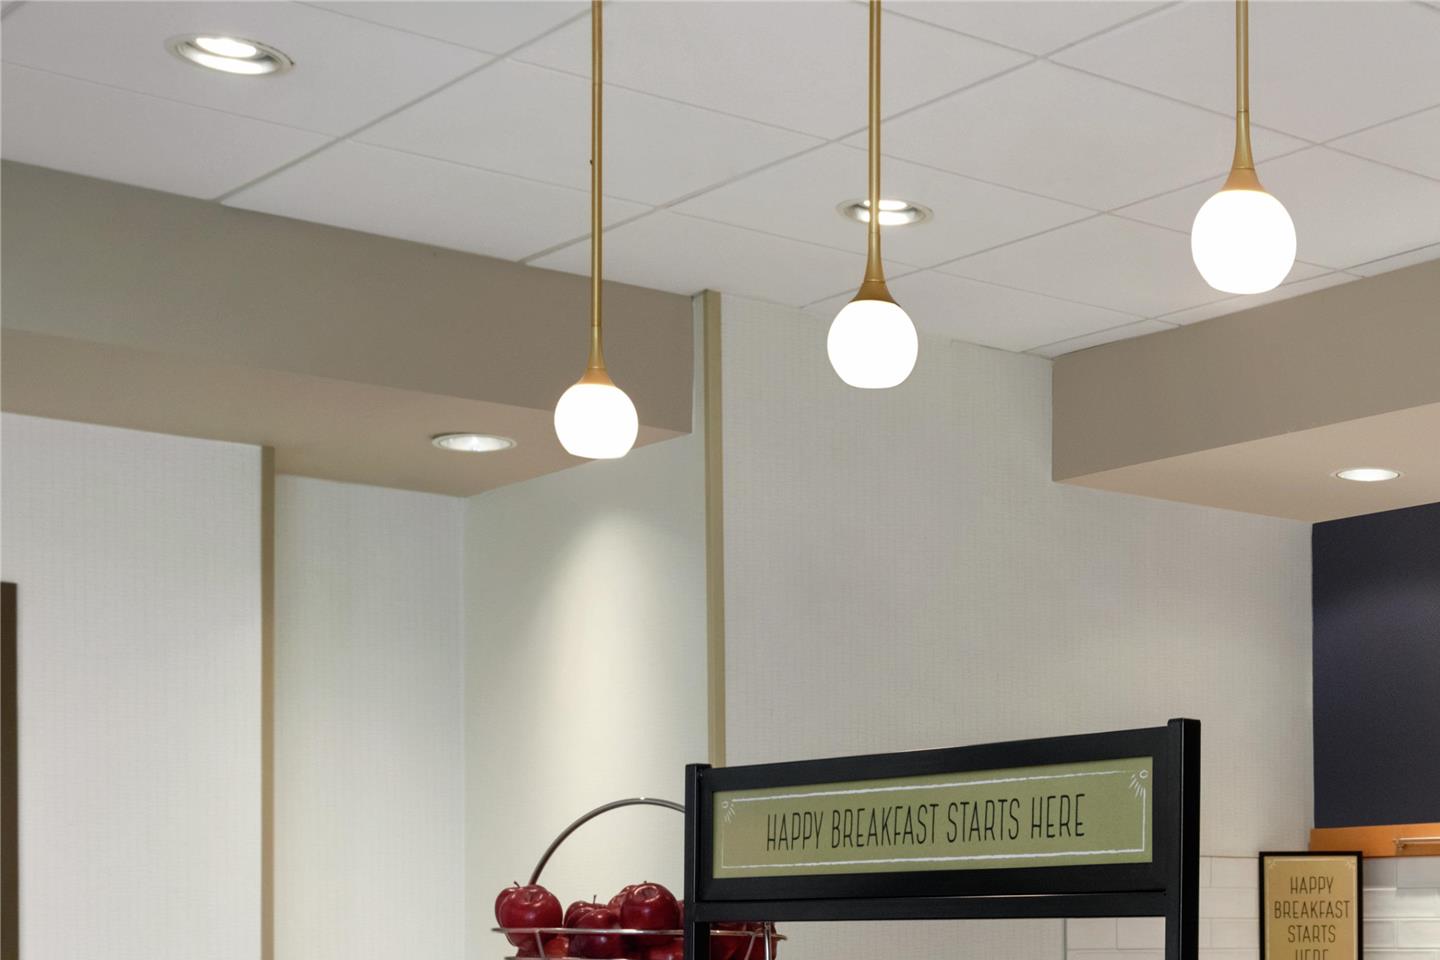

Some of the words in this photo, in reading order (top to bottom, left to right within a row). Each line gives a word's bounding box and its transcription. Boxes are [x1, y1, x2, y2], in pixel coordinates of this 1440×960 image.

[766, 811, 824, 851] HAPPY
[831, 803, 939, 849] BREAKFAST
[946, 798, 1020, 843] STARTS
[1031, 794, 1085, 839] HERE
[1290, 876, 1334, 895] HAPPY
[1274, 900, 1350, 919] BREAKFAST
[1288, 924, 1336, 943] STARTS
